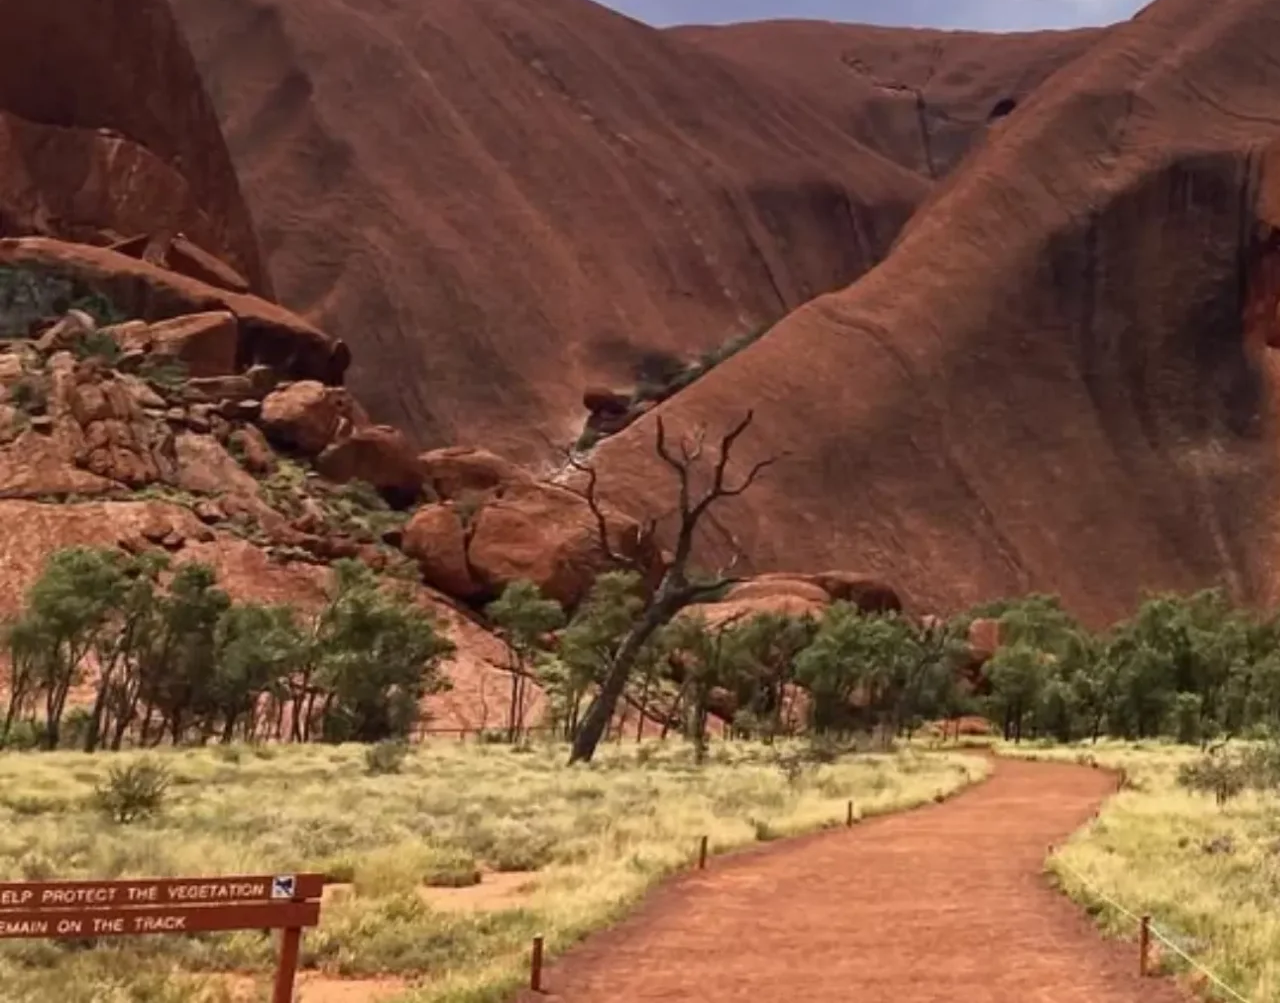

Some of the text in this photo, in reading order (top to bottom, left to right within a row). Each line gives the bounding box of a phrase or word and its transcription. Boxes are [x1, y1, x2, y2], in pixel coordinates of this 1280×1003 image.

[1, 882, 264, 904] ELP PROTECT THE VEGETATION
[0, 916, 186, 934] EMAIN ON THE TRACK
